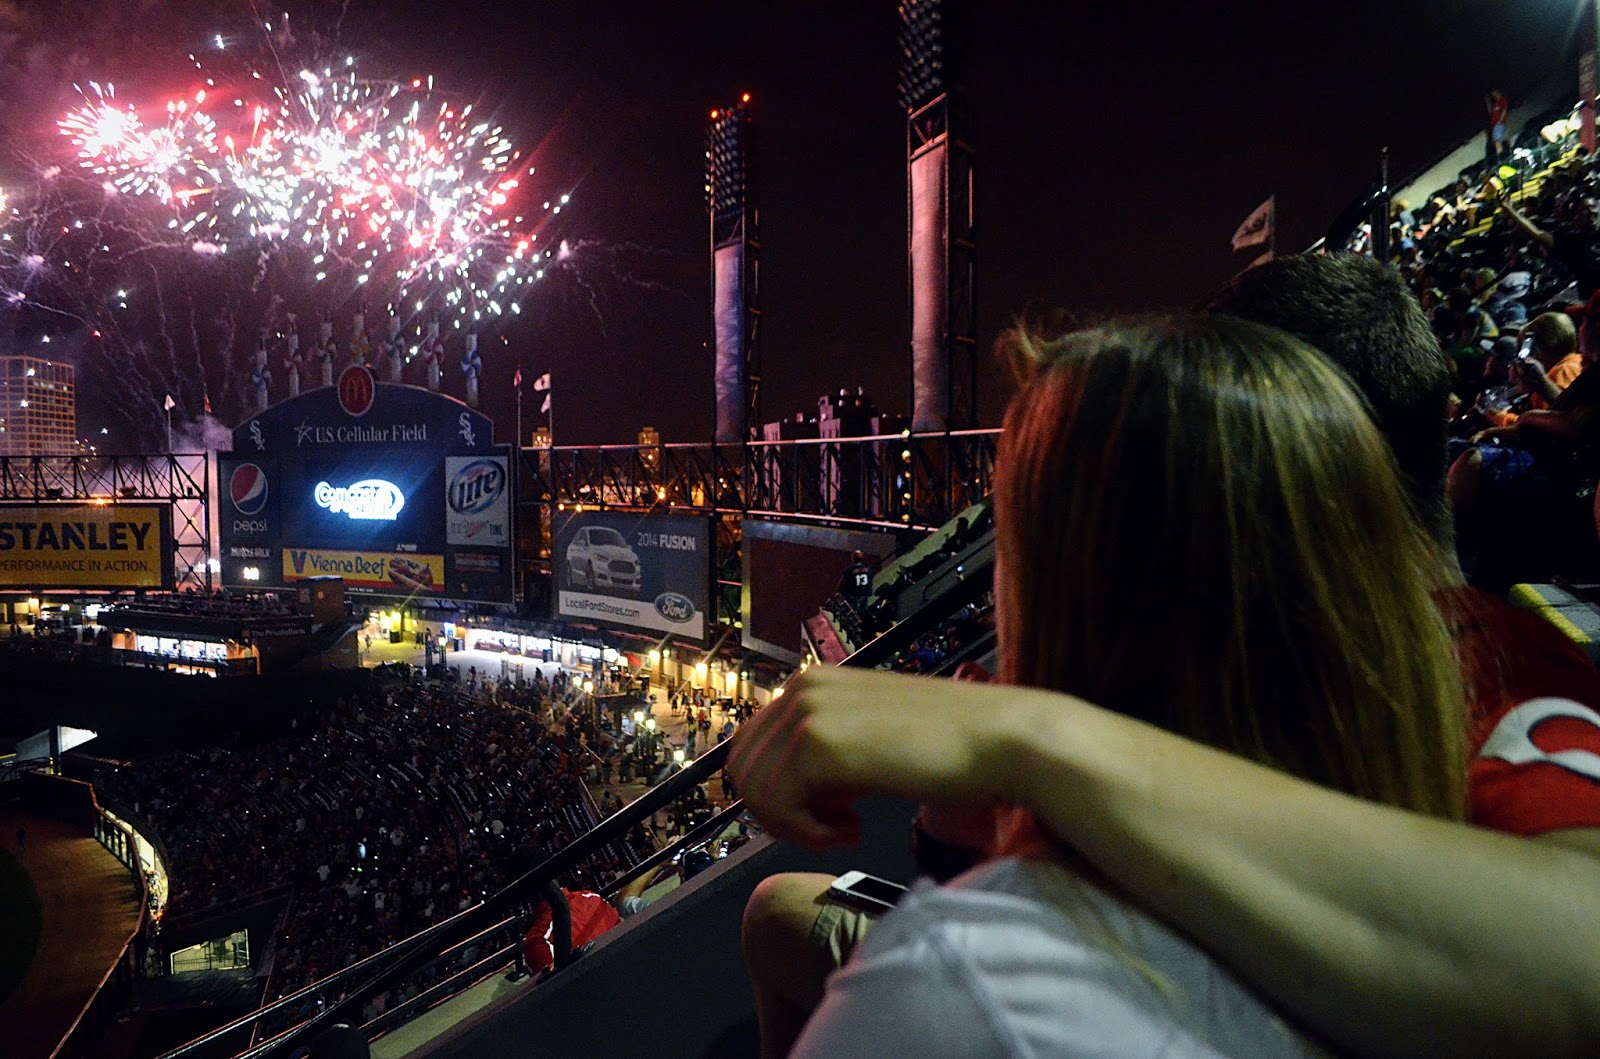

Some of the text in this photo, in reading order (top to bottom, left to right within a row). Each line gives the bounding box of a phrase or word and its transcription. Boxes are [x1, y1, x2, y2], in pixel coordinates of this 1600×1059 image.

[337, 425, 389, 443] Cellular
[392, 423, 427, 441] Field
[0, 522, 149, 550] STANLEY
[233, 518, 268, 534] pepsi
[637, 531, 697, 551] 2014 FUSION
[89, 560, 100, 571] IN
[310, 552, 354, 573] Vienna
[356, 555, 385, 579] Beef
[855, 573, 869, 586] 13
[565, 598, 640, 618] LocalFordStores.com
[662, 596, 688, 619] Ford
